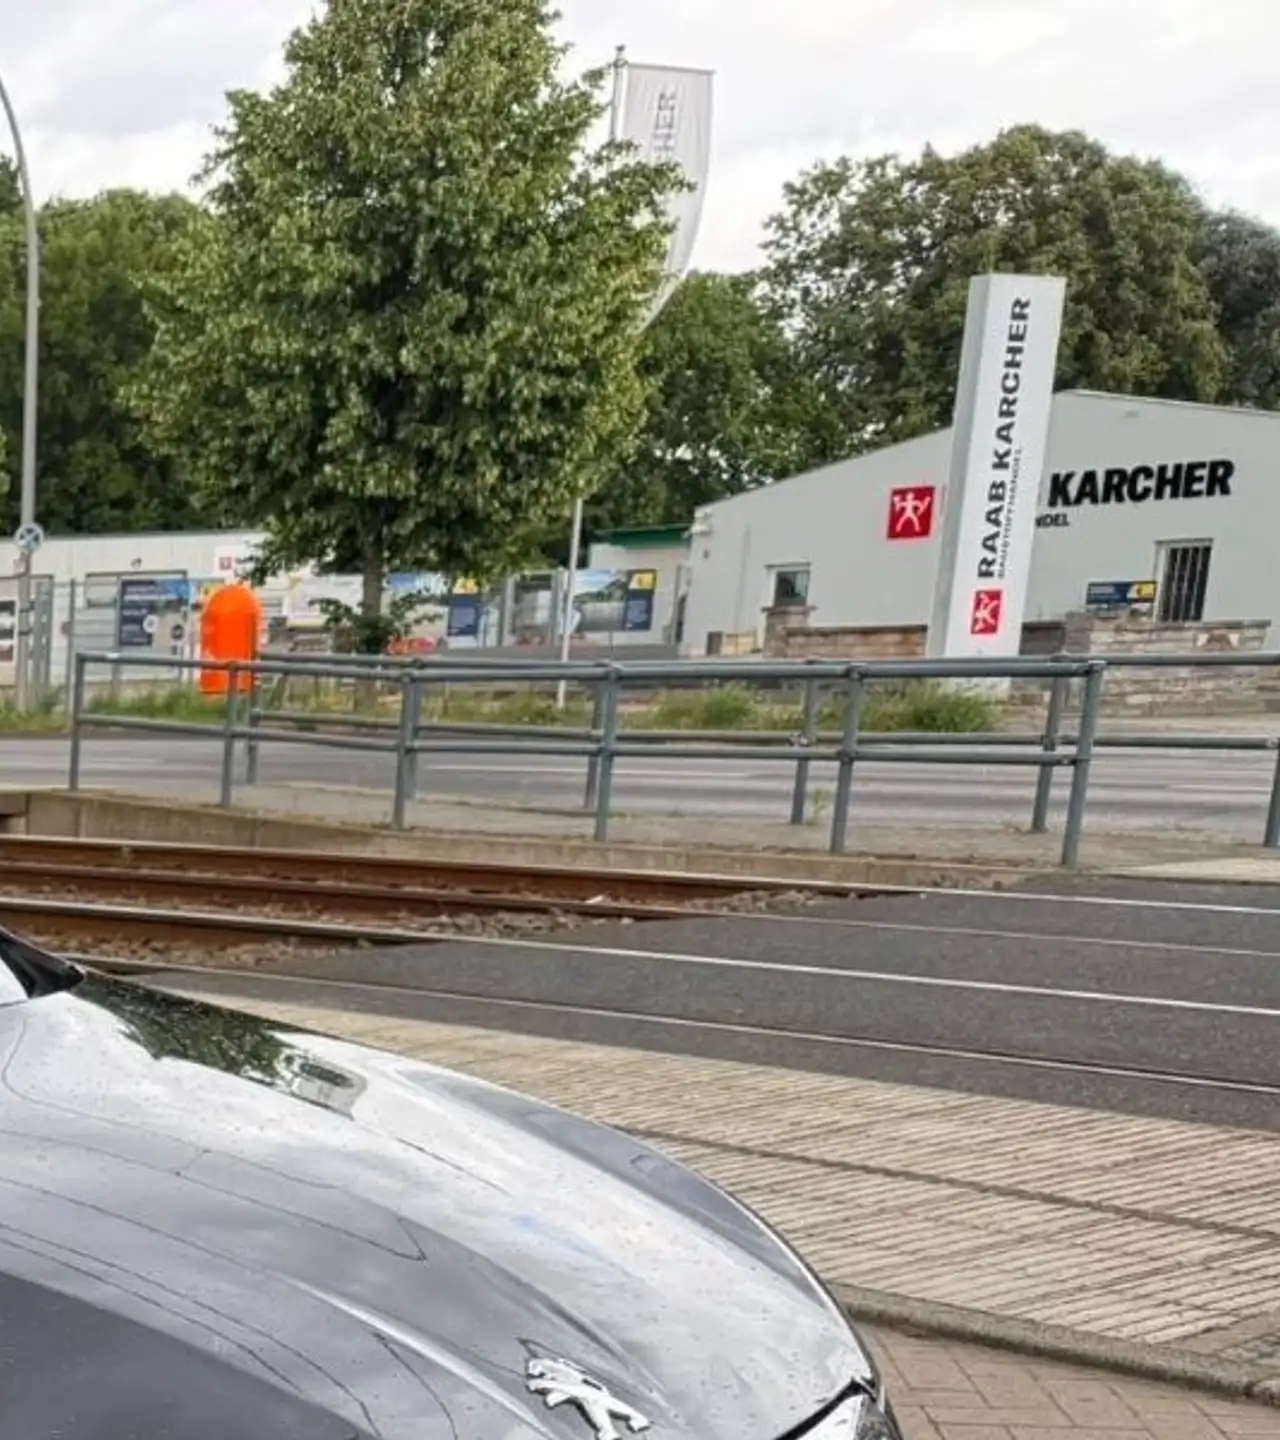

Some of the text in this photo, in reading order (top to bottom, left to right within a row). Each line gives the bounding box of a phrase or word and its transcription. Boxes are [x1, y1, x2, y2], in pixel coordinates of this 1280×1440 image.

[977, 297, 1031, 578] RAAB KARCHER
[1047, 459, 1235, 508] KARCHER
